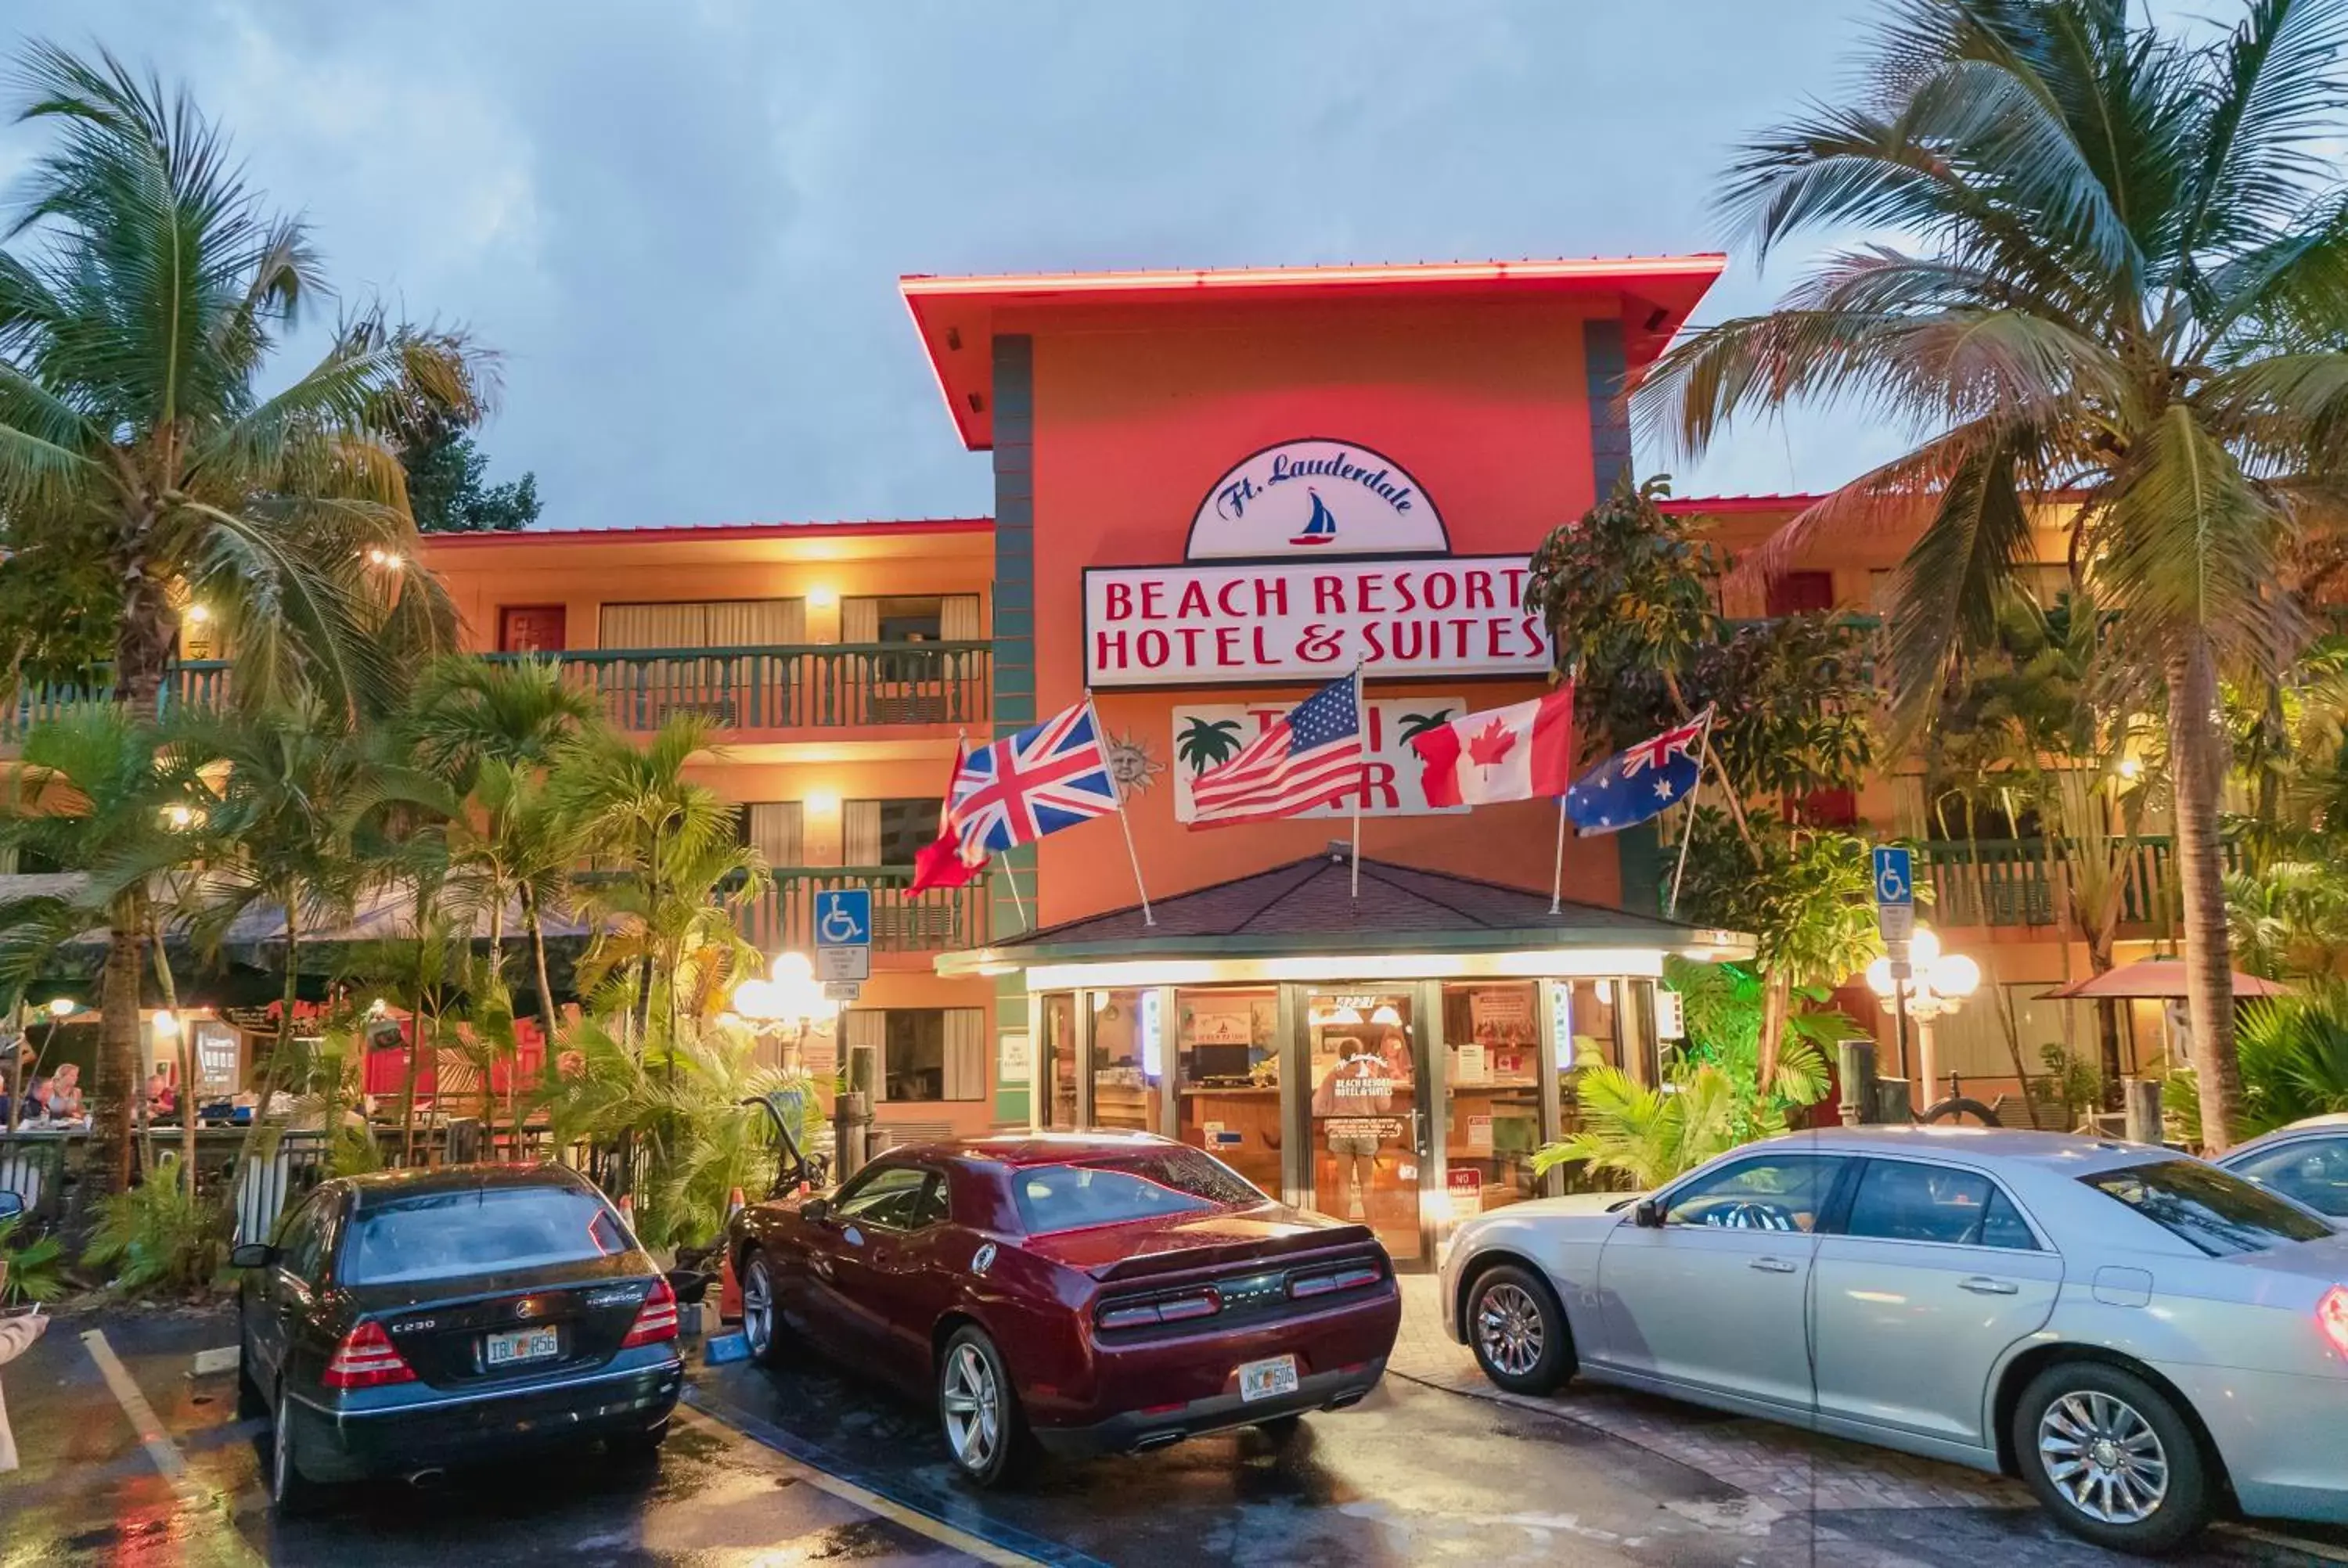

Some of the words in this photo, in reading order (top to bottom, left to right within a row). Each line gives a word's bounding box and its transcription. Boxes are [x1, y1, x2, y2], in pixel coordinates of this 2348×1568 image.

[1215, 475, 1263, 521] Ft.
[1267, 451, 1412, 516] Lauderdale
[1105, 577, 1288, 621] BEACH
[1313, 569, 1528, 614] RESORT
[1097, 625, 1282, 671] HOTEL
[1295, 624, 1345, 663] &
[1362, 616, 1545, 663] SUITES
[1247, 707, 1381, 753] TI
[1456, 1174, 1469, 1184] NO
